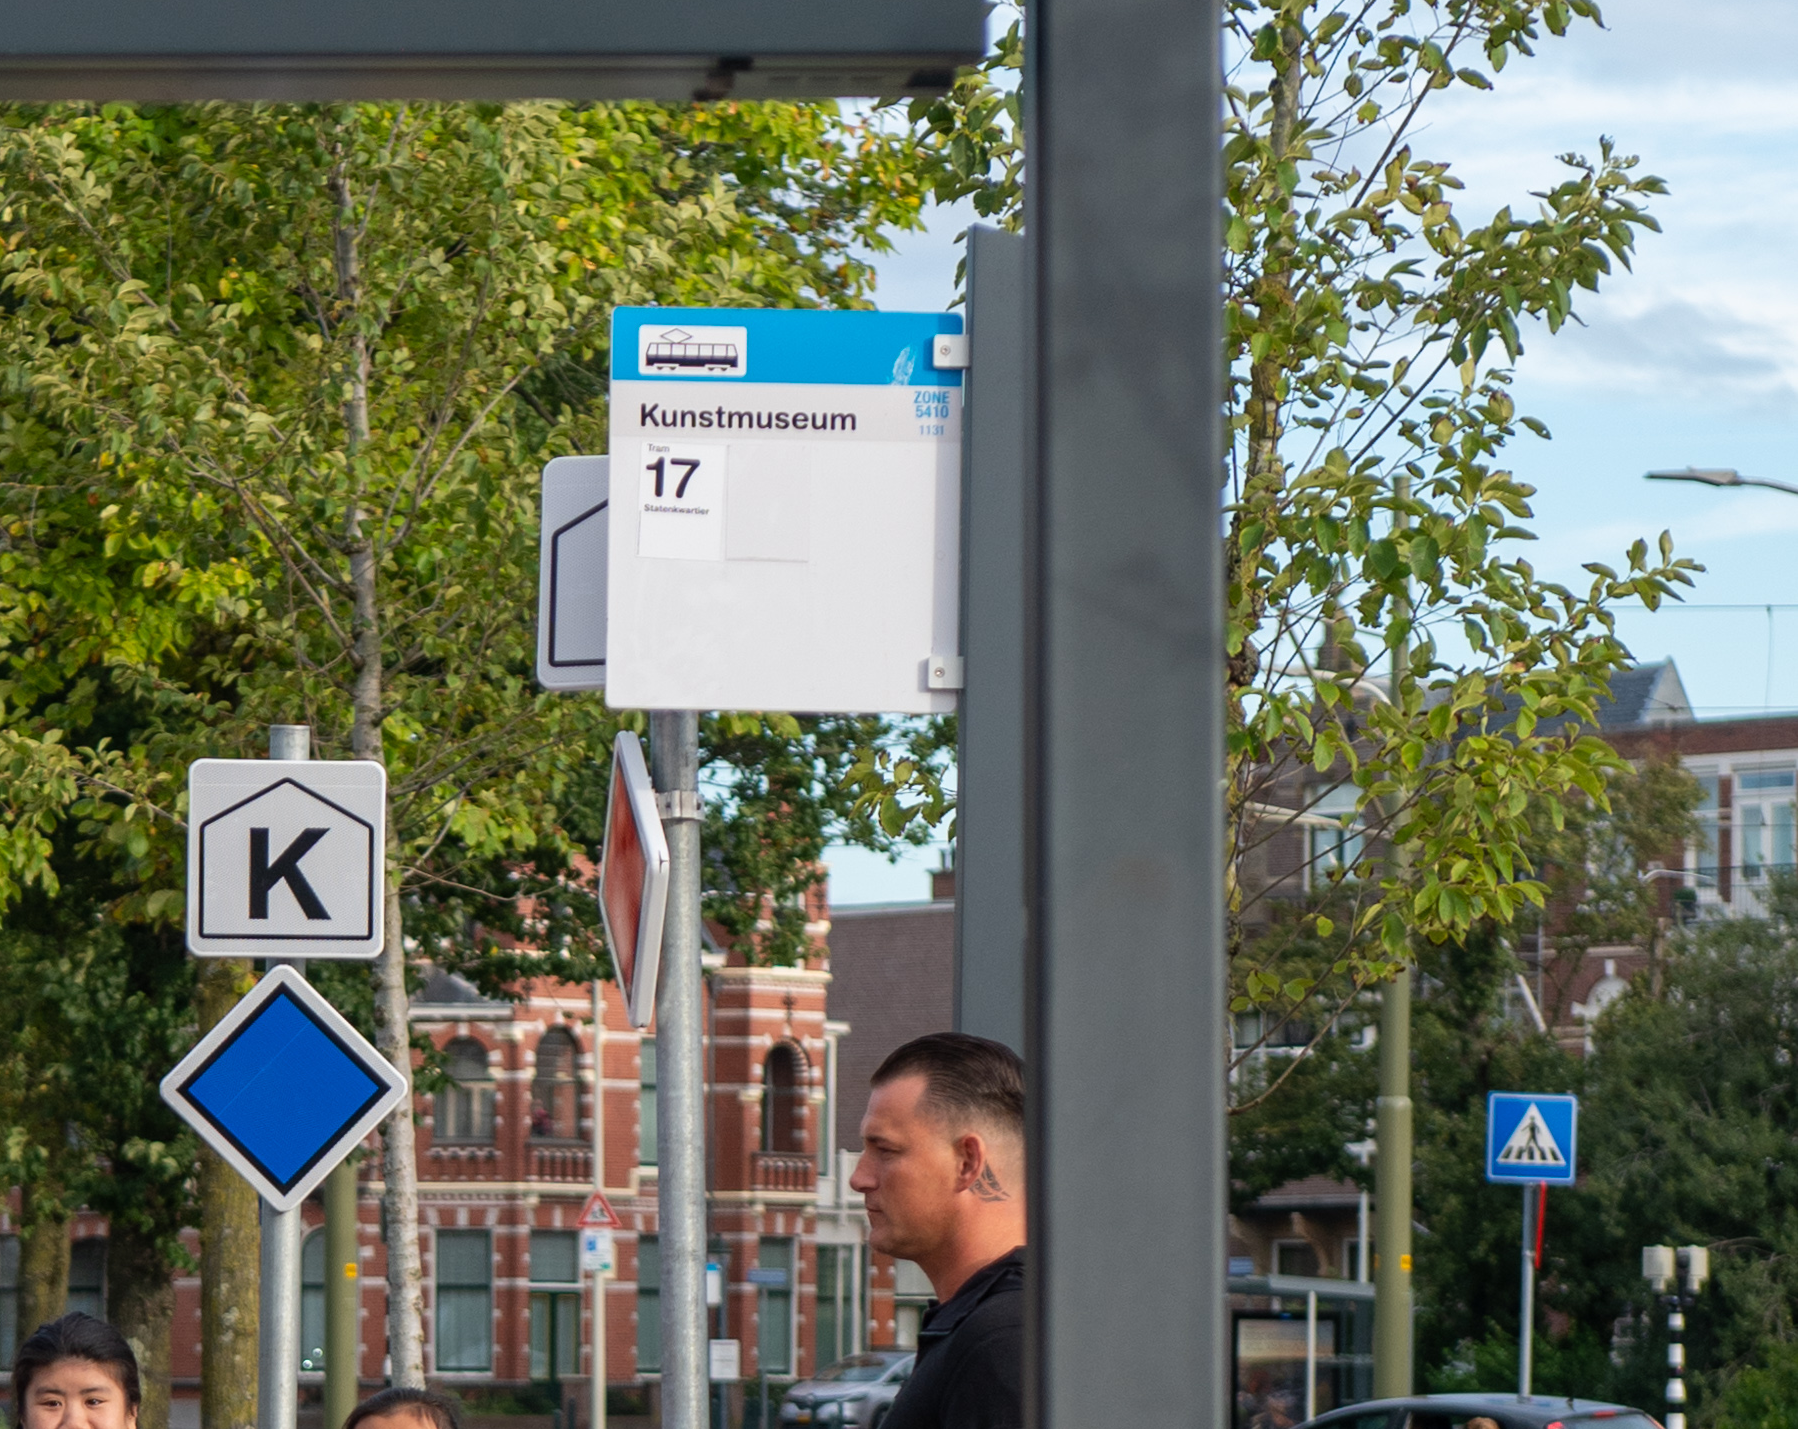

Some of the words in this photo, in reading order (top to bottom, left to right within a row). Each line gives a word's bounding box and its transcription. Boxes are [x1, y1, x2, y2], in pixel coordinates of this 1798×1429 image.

[913, 390, 950, 404] ZONE
[640, 402, 857, 431] Kunstmuseum
[915, 404, 949, 418] 5410
[647, 443, 671, 453] Tram
[645, 456, 701, 499] 17
[644, 503, 710, 515] Statenkwartier
[248, 827, 332, 920] K
